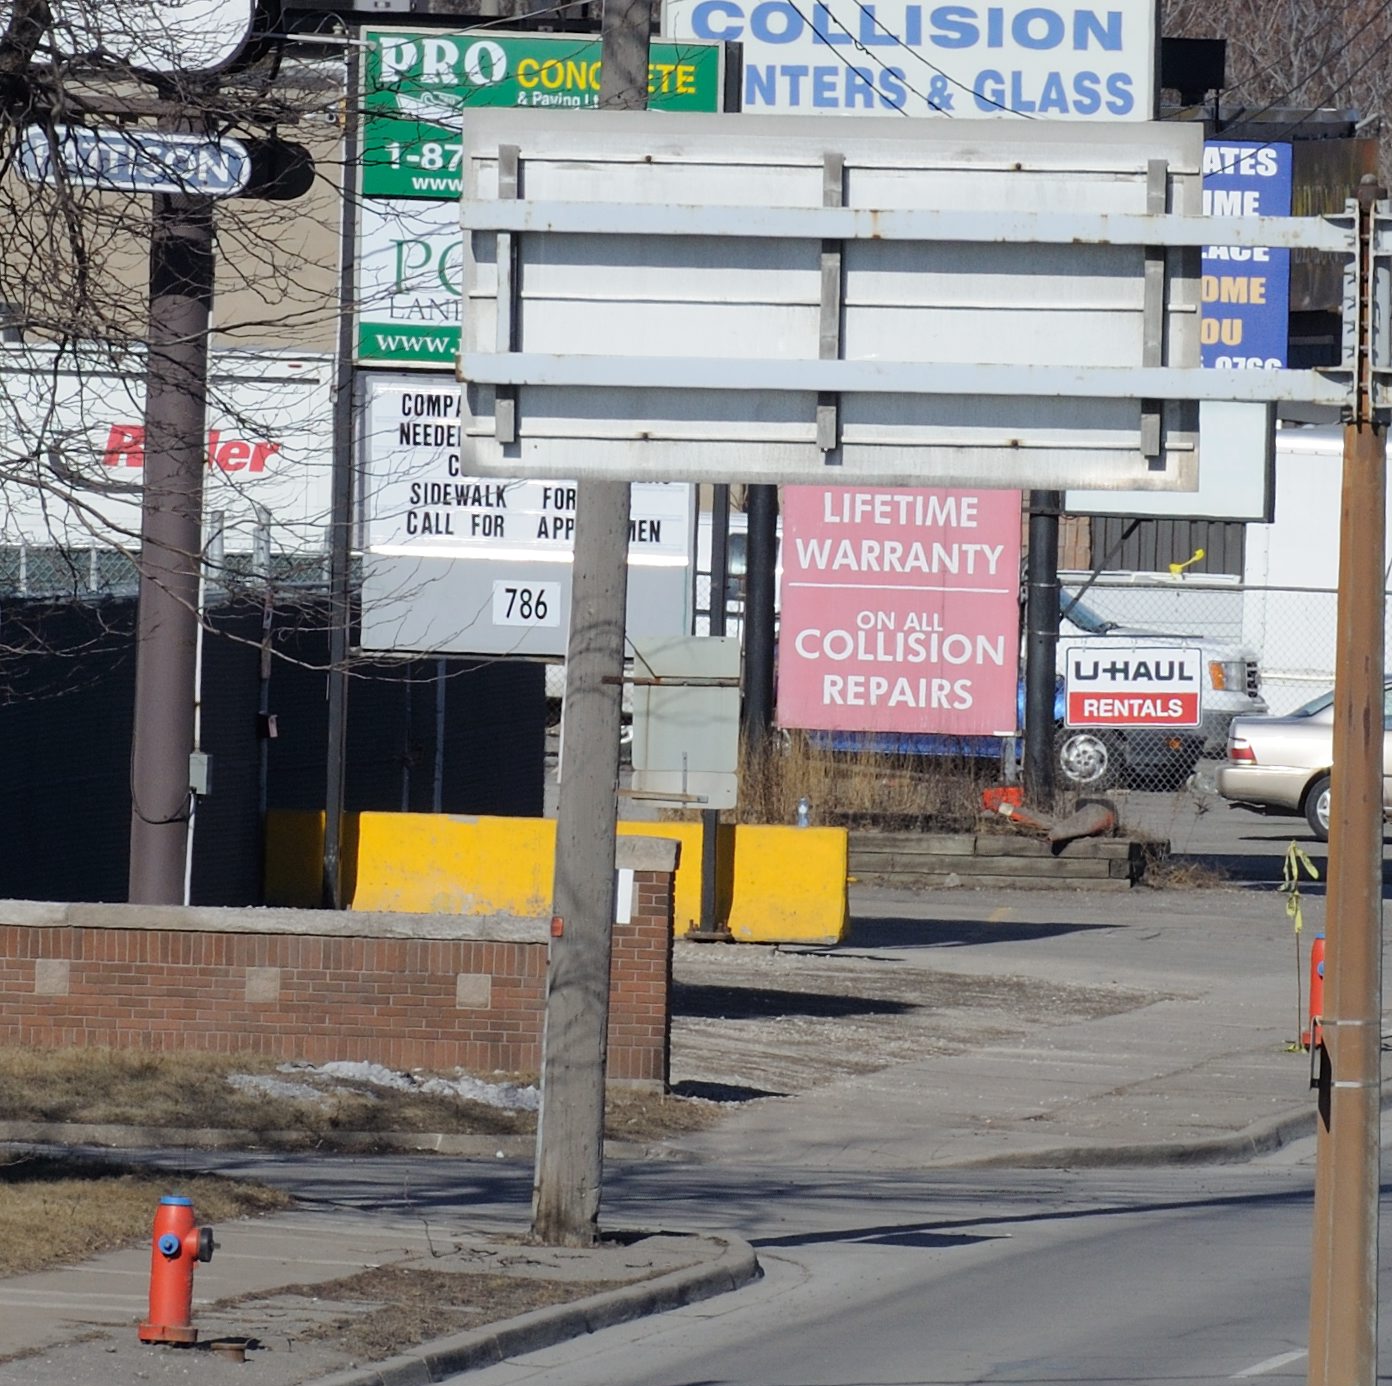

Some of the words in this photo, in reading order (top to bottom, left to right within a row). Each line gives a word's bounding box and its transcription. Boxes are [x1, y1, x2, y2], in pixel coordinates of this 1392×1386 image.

[691, 0, 1123, 51] COLLISION
[379, 37, 507, 85] PRO
[517, 91, 528, 105] &
[533, 91, 580, 110] Paving
[928, 75, 953, 110] &
[974, 69, 1134, 115] GLASS
[410, 482, 507, 511] SIDEWALK
[824, 491, 978, 529] LIFETIME
[407, 511, 454, 536] CALL
[471, 513, 504, 538] FOR
[796, 538, 1004, 576] WARRANTY
[504, 588, 548, 620] 786
[856, 610, 897, 631] ON
[903, 611, 943, 632] ALL
[795, 628, 1005, 667] COLLISION
[1074, 660, 1193, 682] U-HAUL
[822, 675, 973, 711] REPAIRS
[1083, 698, 1183, 718] RENTALS
